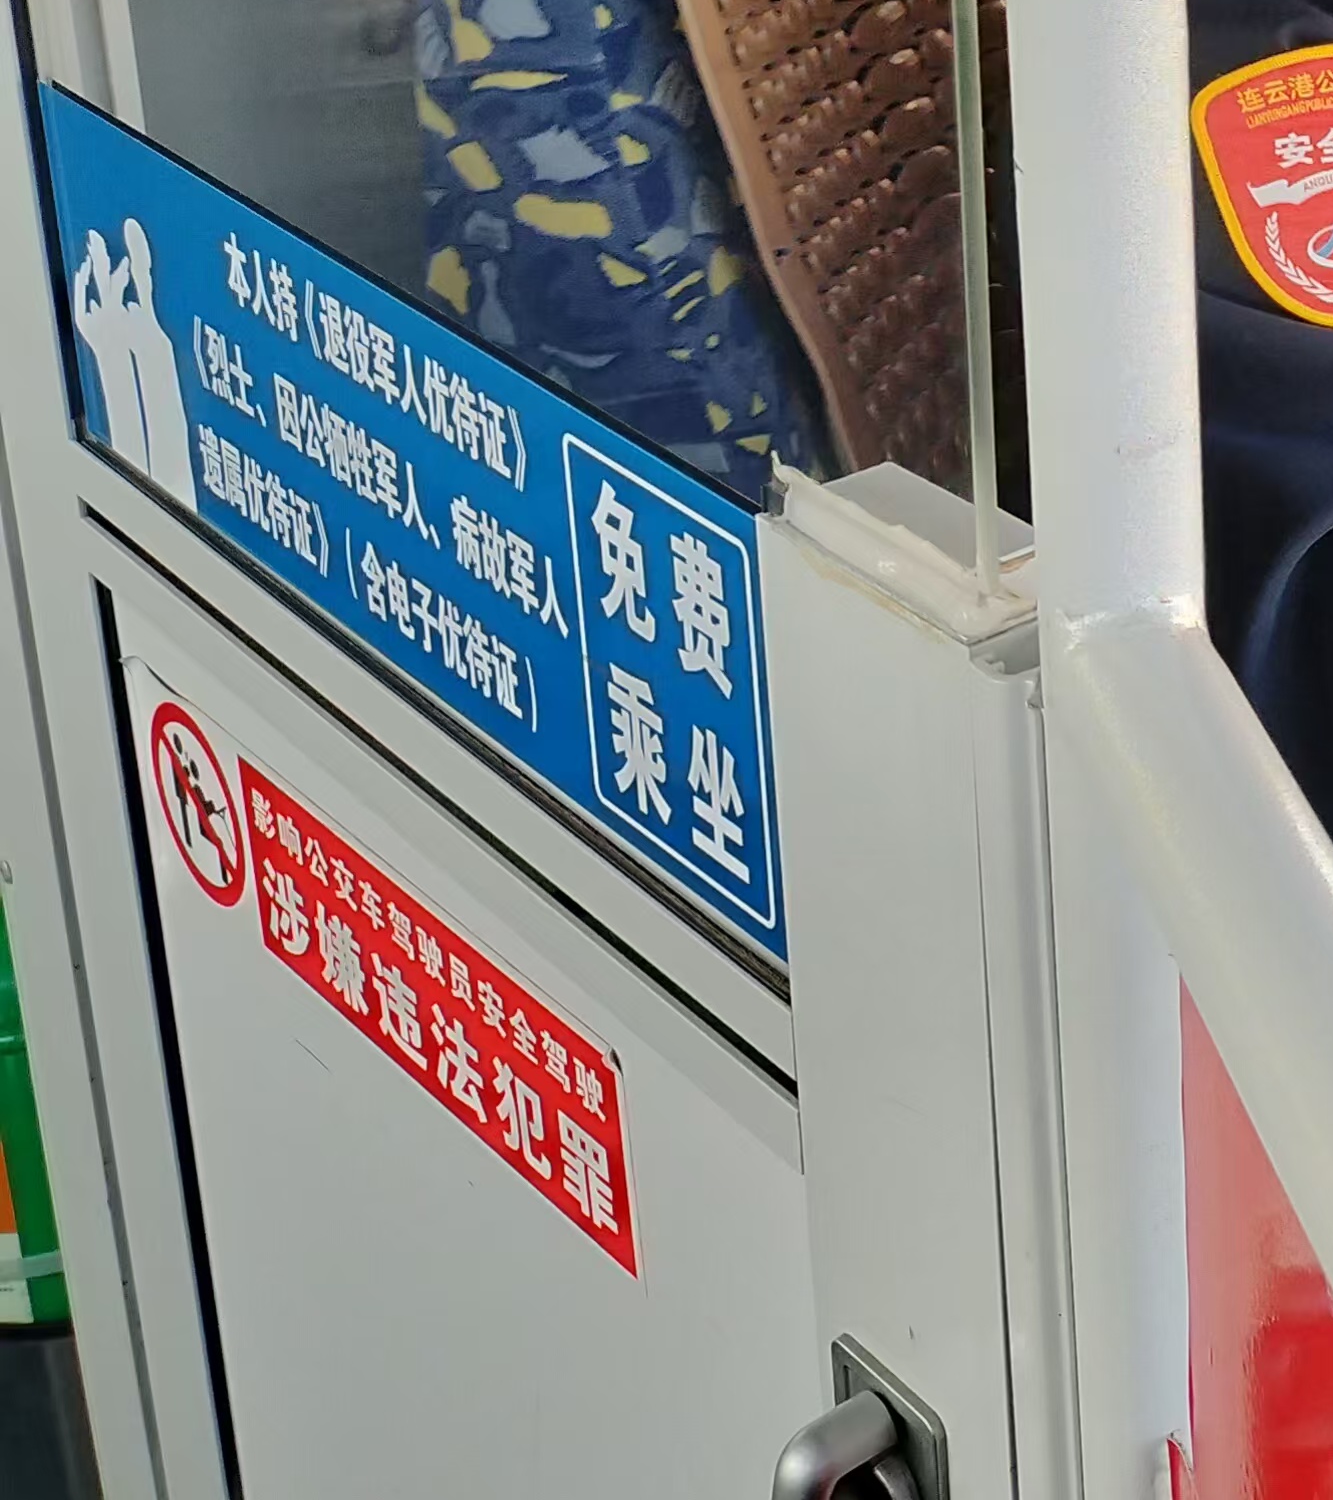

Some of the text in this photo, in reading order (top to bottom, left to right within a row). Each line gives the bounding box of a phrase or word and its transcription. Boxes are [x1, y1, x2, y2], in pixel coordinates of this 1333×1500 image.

[591, 479, 732, 700] 免费
[608, 662, 750, 885] 乘坐
[250, 787, 606, 1123] 影响公交车驾驶员安全驾驶
[261, 858, 619, 1235] 涉嫌违法犯罪
